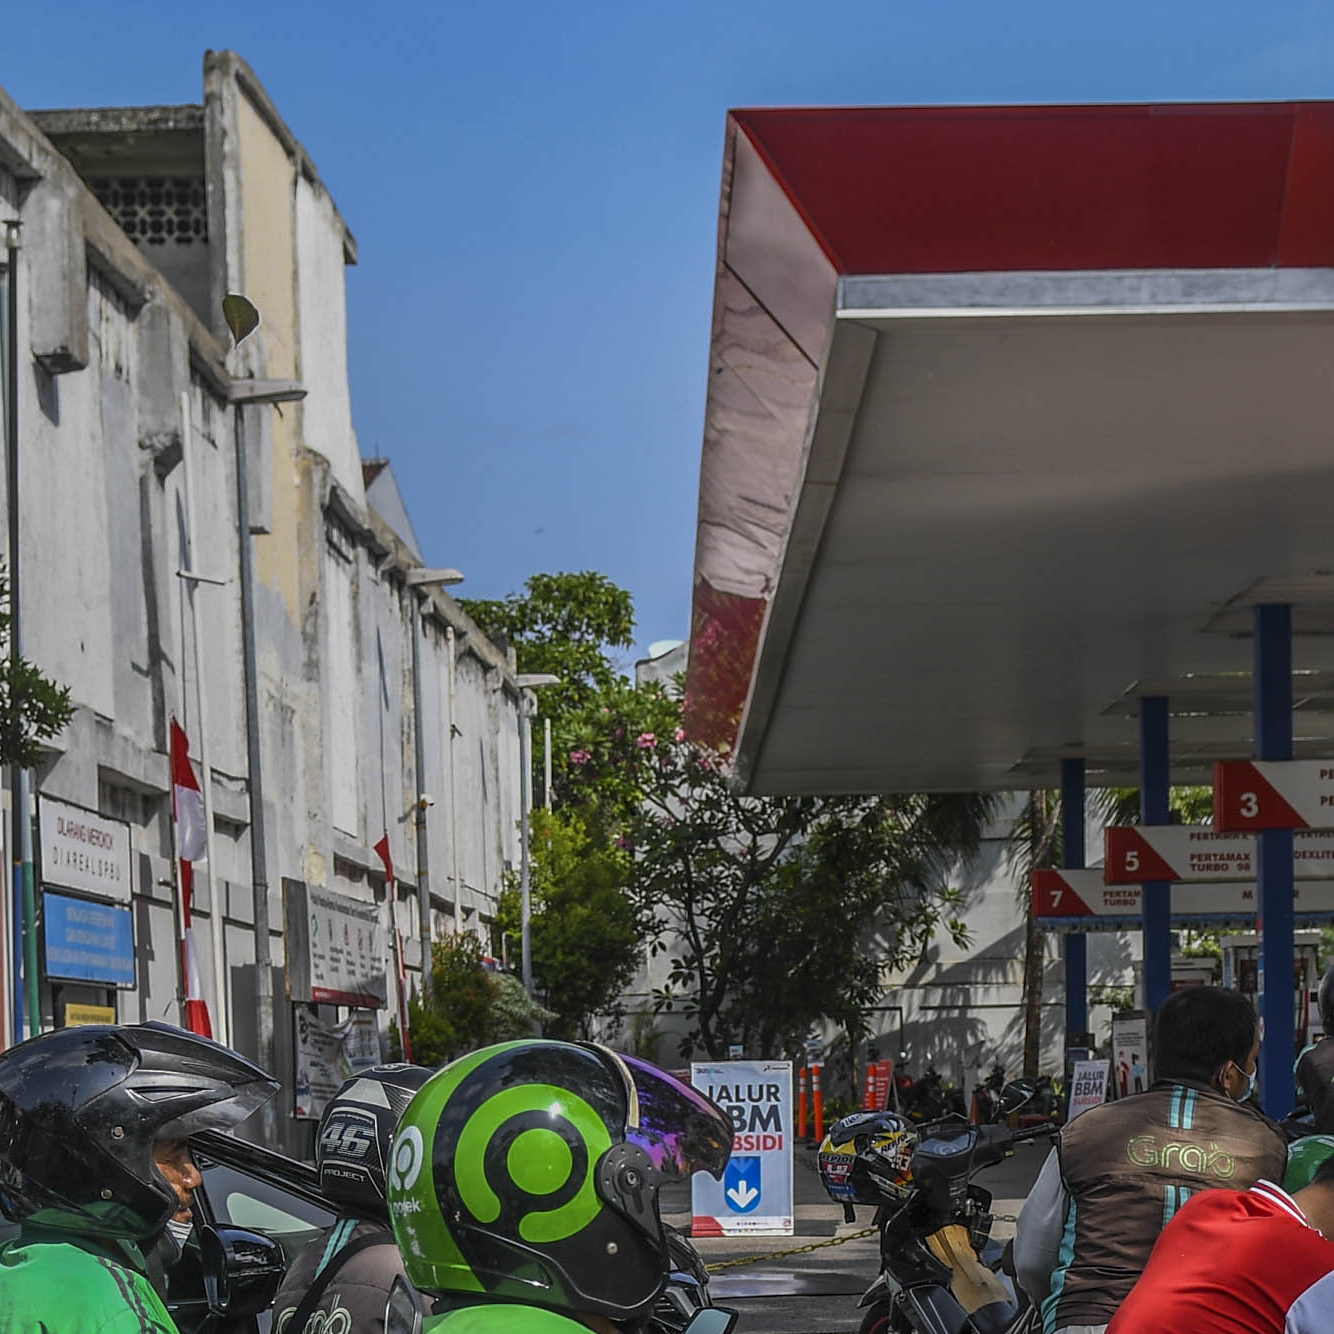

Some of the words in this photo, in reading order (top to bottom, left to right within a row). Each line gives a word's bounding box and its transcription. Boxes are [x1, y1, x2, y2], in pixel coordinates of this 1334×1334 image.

[1239, 792, 1259, 818] 3
[1125, 851, 1140, 872] 5
[1189, 853, 1251, 862] PERTAMAX
[1190, 863, 1229, 872] TURBO
[1050, 890, 1063, 908] 7
[1103, 890, 1141, 899] PERTAM
[1074, 1081, 1103, 1096] BBM
[726, 1104, 783, 1133] BM
[321, 1122, 375, 1157] 46
[1127, 1135, 1236, 1178] Grab
[324, 1168, 366, 1182] PROJECT
